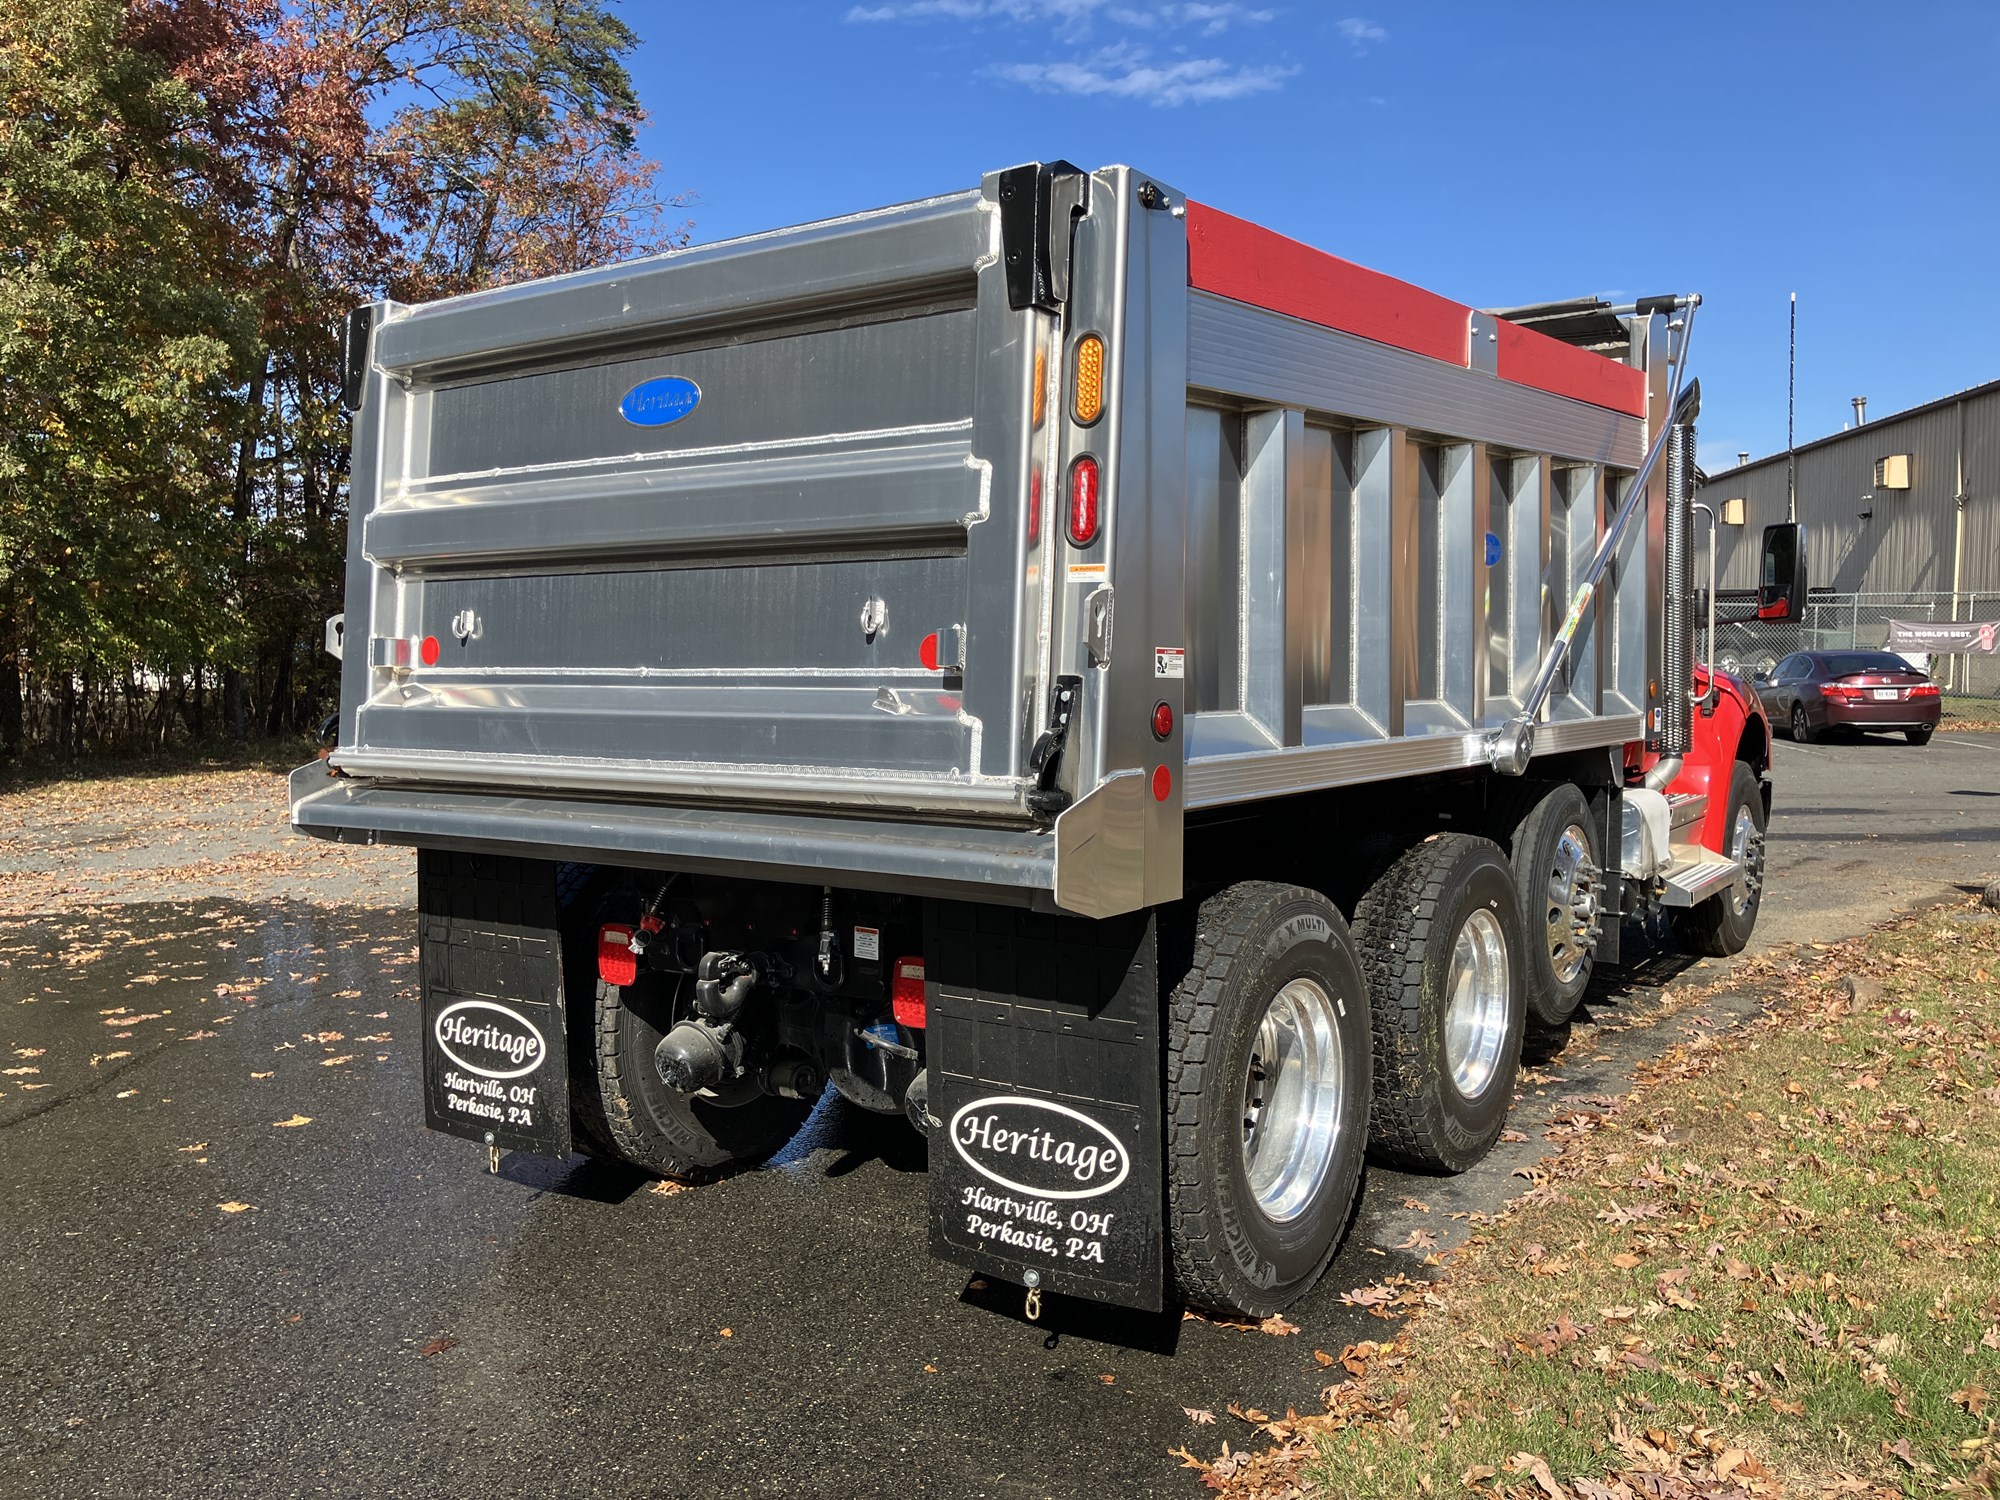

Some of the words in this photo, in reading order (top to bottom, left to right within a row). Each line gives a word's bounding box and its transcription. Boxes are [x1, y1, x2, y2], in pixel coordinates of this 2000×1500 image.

[1284, 922, 1296, 939] X
[1297, 918, 1325, 932] MULTI
[441, 1016, 539, 1064] Heritage
[443, 1072, 507, 1104] Hartville,
[510, 1086, 537, 1105] OH
[447, 1093, 505, 1123] Perkasie,
[508, 1107, 533, 1126] PA
[960, 1115, 1117, 1181] Heritage
[961, 1186, 1063, 1230] Hartville,
[1070, 1210, 1114, 1236] OH
[966, 1214, 1058, 1257] Perkasie,
[1065, 1237, 1105, 1263] PA
